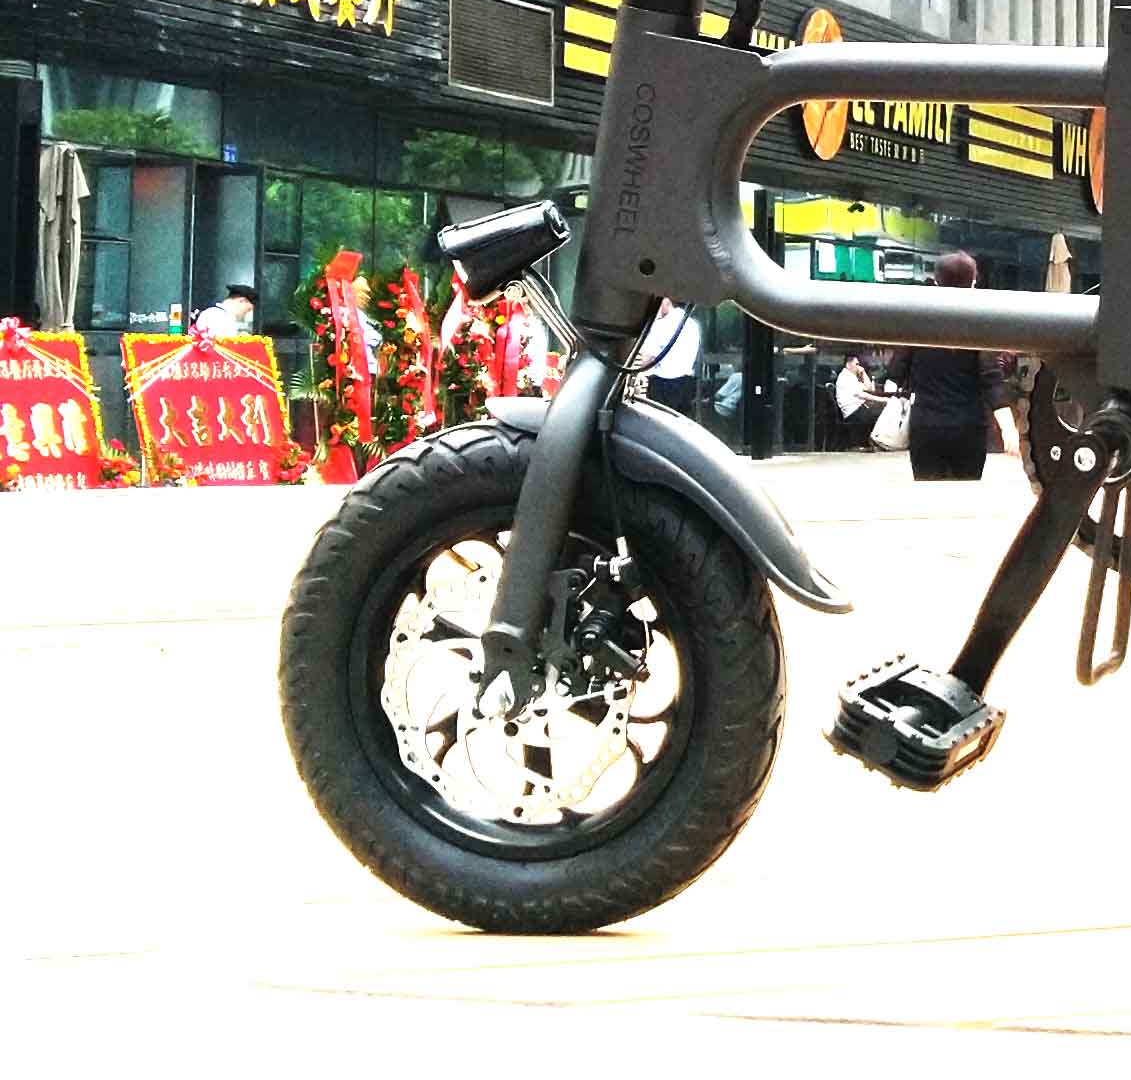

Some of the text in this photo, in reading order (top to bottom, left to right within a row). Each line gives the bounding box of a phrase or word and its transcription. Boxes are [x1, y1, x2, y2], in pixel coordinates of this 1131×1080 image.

[613, 82, 656, 239] COSWHEEL
[850, 132, 871, 152] BEST
[871, 136, 891, 159] TASTE
[159, 394, 275, 447] 大吉大利
